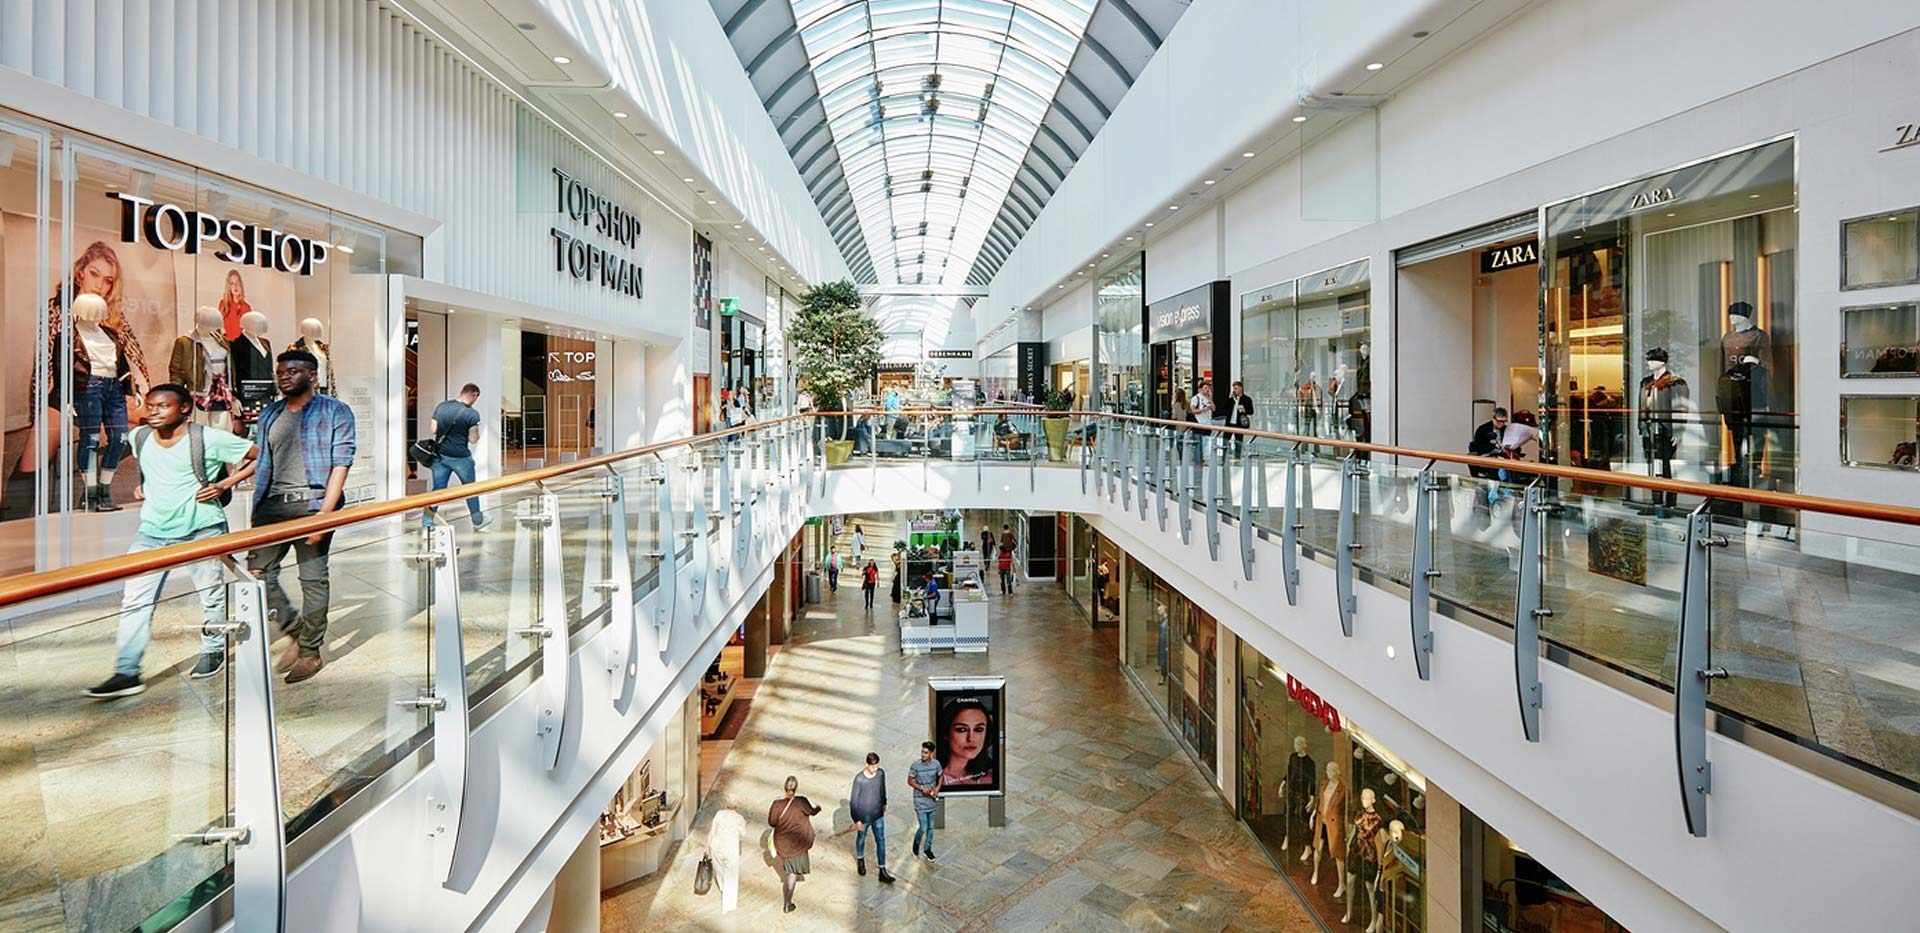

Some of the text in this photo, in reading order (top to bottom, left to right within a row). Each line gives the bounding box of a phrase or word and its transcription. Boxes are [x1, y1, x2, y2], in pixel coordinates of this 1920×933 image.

[552, 167, 641, 249] TOPSHOP
[1631, 187, 1676, 209] ZARA
[105, 192, 331, 275] TOPSHOP
[1491, 245, 1536, 268] ZARA
[551, 227, 643, 299] TOPMAN
[563, 352, 595, 363] TOP
